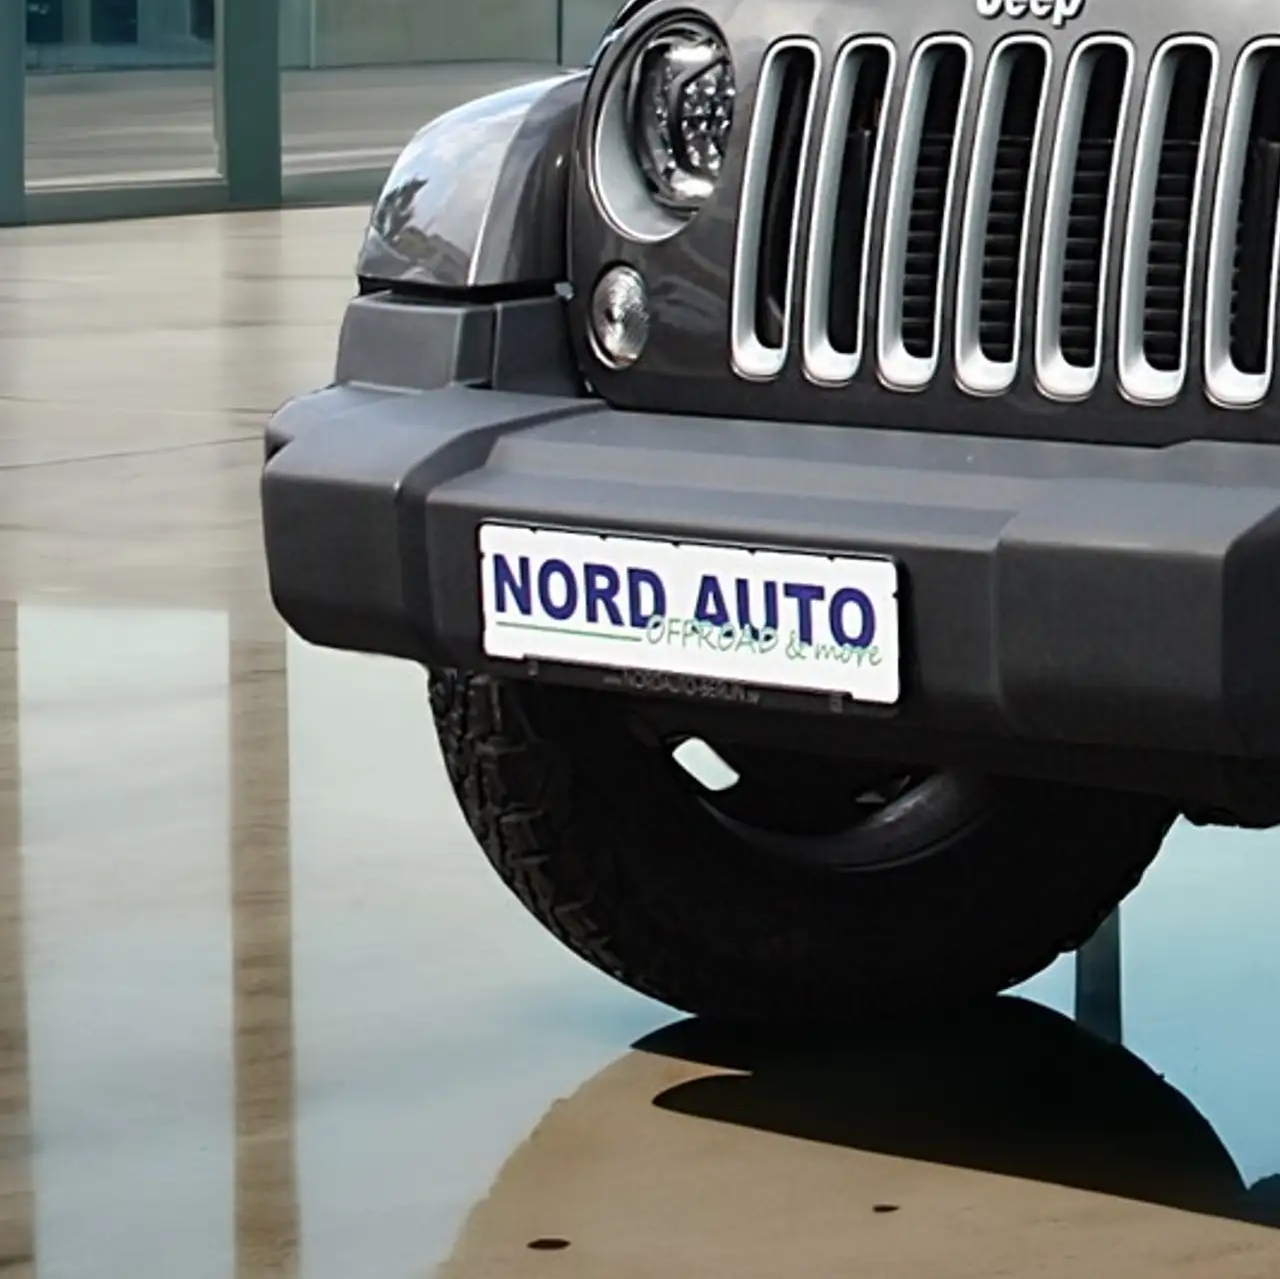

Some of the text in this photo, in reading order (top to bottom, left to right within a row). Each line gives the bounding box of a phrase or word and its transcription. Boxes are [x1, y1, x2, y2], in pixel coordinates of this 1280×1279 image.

[492, 553, 877, 649] NORD AUTO
[813, 640, 883, 668] more
